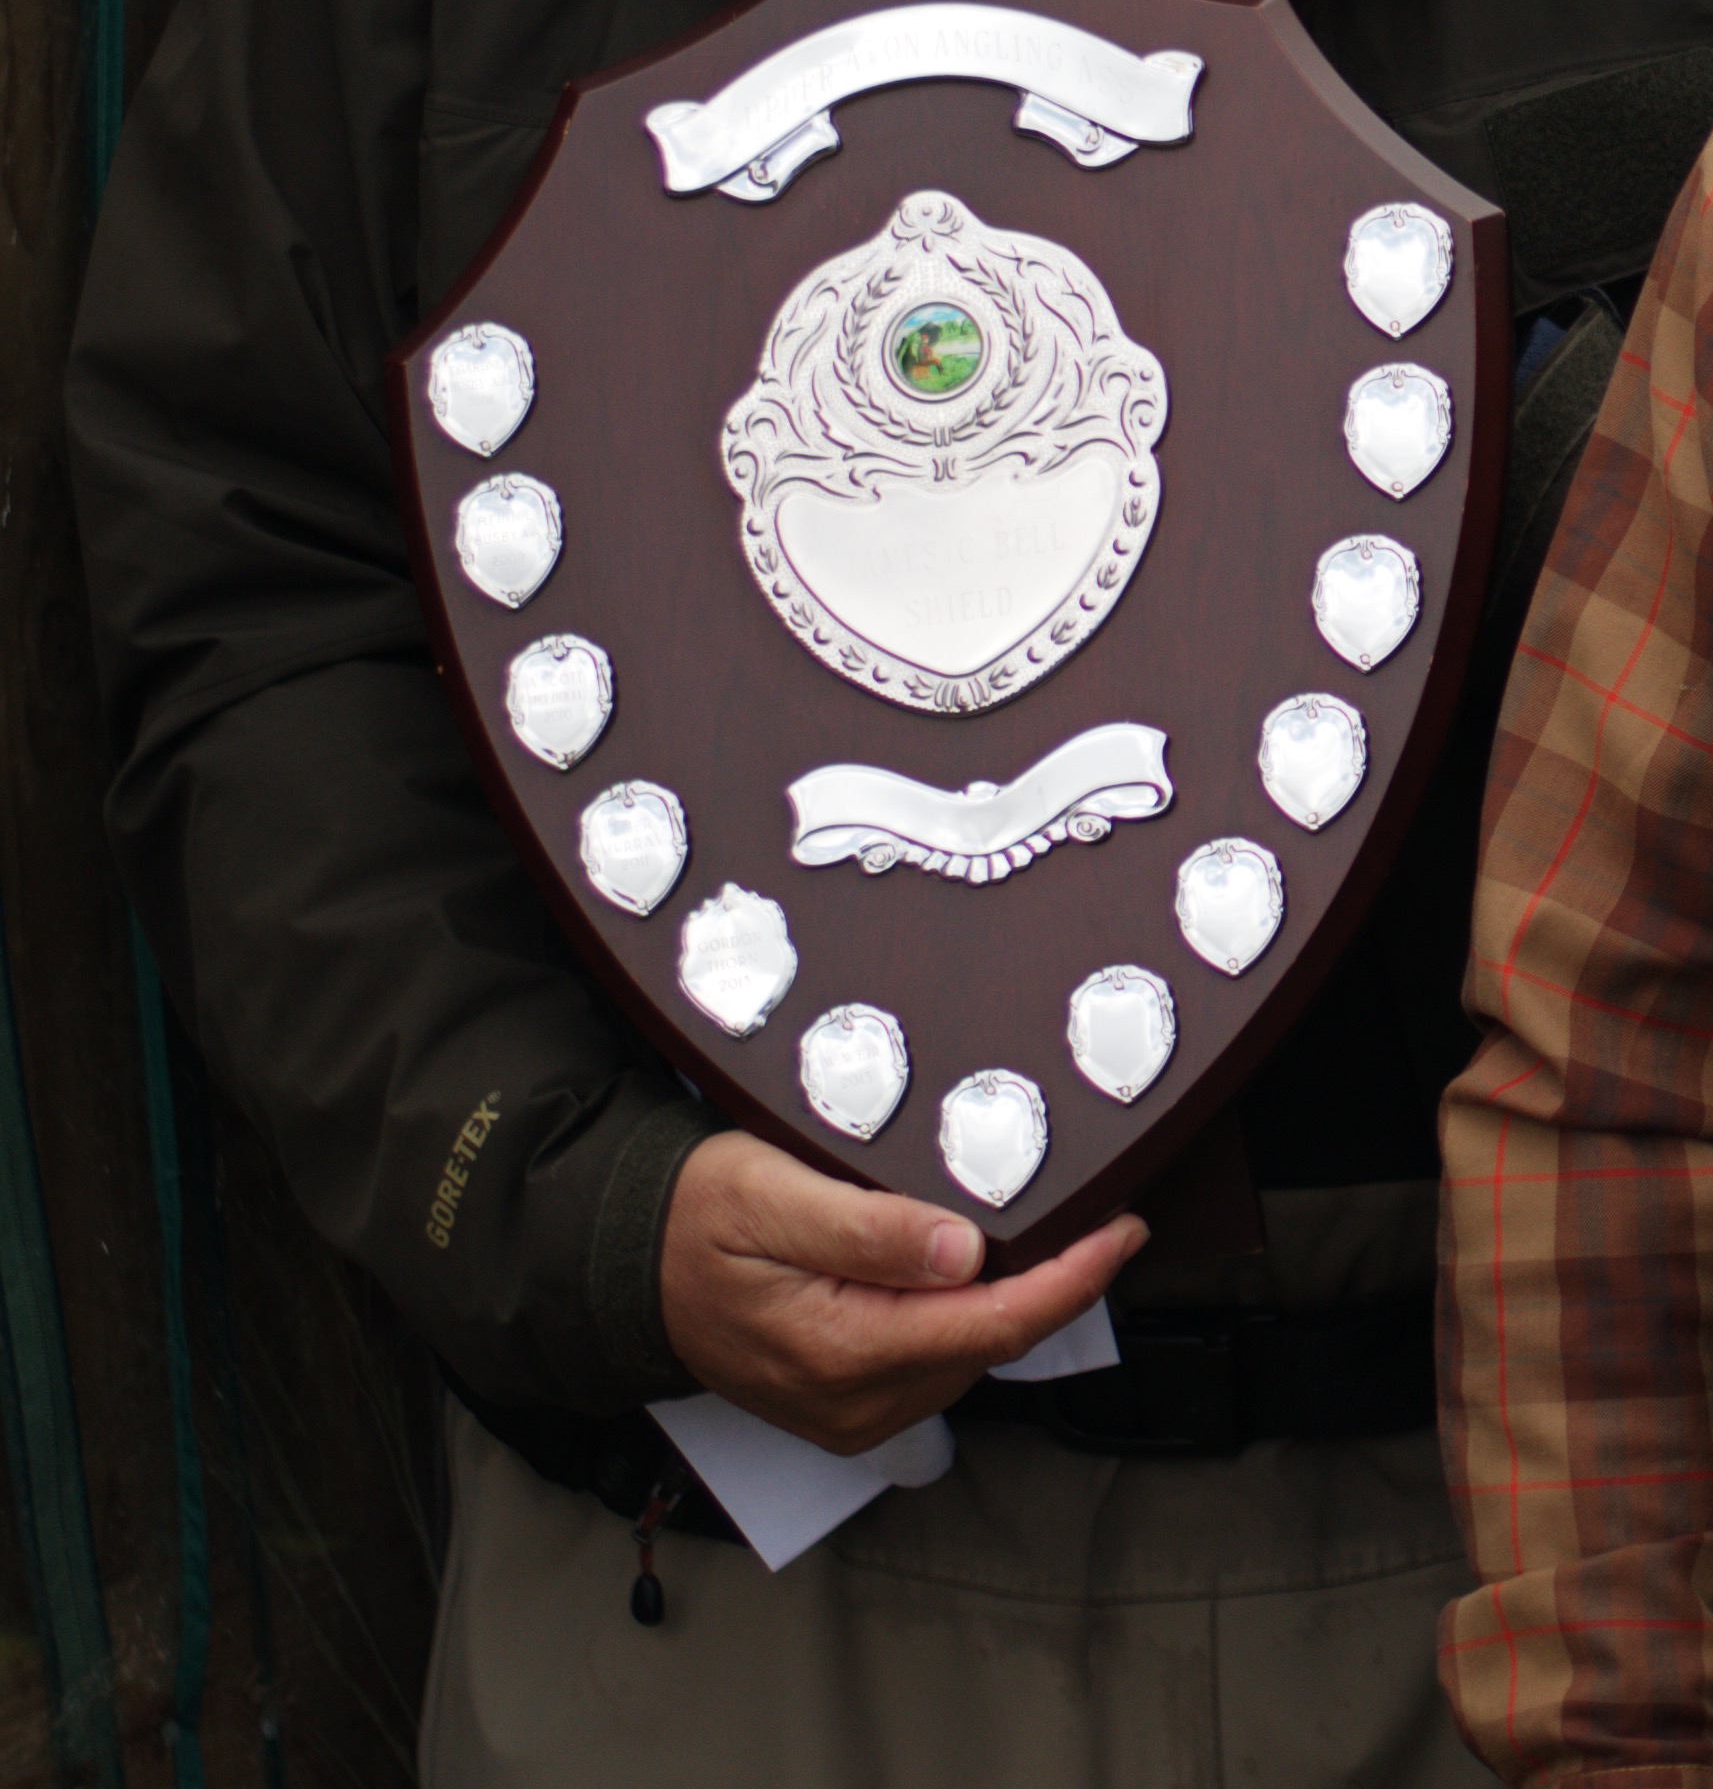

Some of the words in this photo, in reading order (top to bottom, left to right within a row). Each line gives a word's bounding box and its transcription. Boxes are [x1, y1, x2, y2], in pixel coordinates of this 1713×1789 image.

[934, 28, 1064, 73] ANGLING
[840, 540, 937, 582] JAMES
[957, 535, 975, 565] C
[994, 522, 1066, 561] BELL
[904, 585, 1014, 630] SHIELD
[697, 930, 763, 955] GORDON
[706, 952, 760, 974] THORN
[425, 1098, 501, 1250] GORE-TEX
